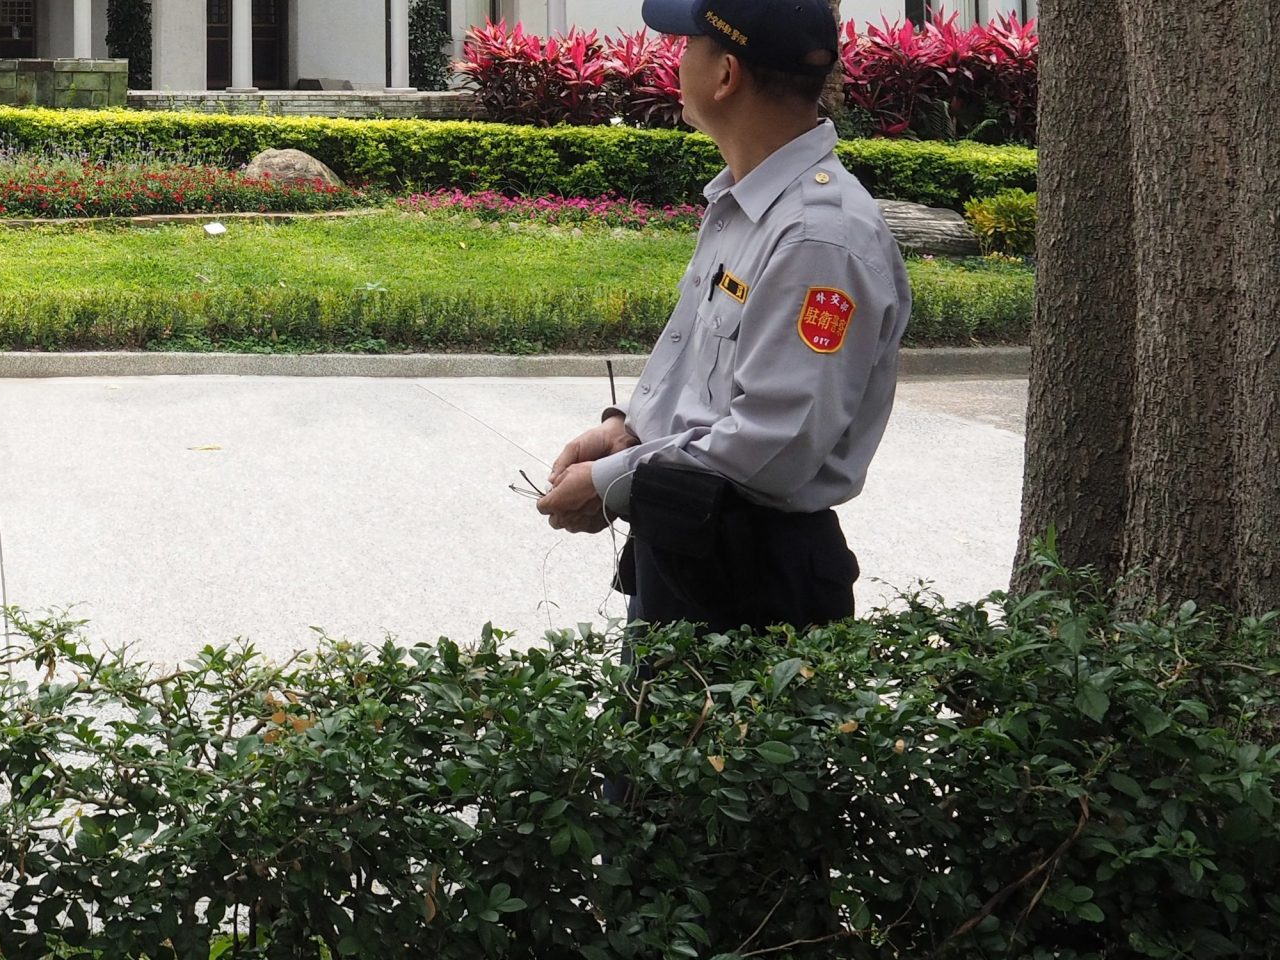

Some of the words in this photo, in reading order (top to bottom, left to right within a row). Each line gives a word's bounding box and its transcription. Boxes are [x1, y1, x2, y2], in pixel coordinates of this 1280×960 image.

[815, 291, 849, 312] 外交部
[804, 306, 847, 336] 駐衛警察
[813, 335, 830, 346] 017
